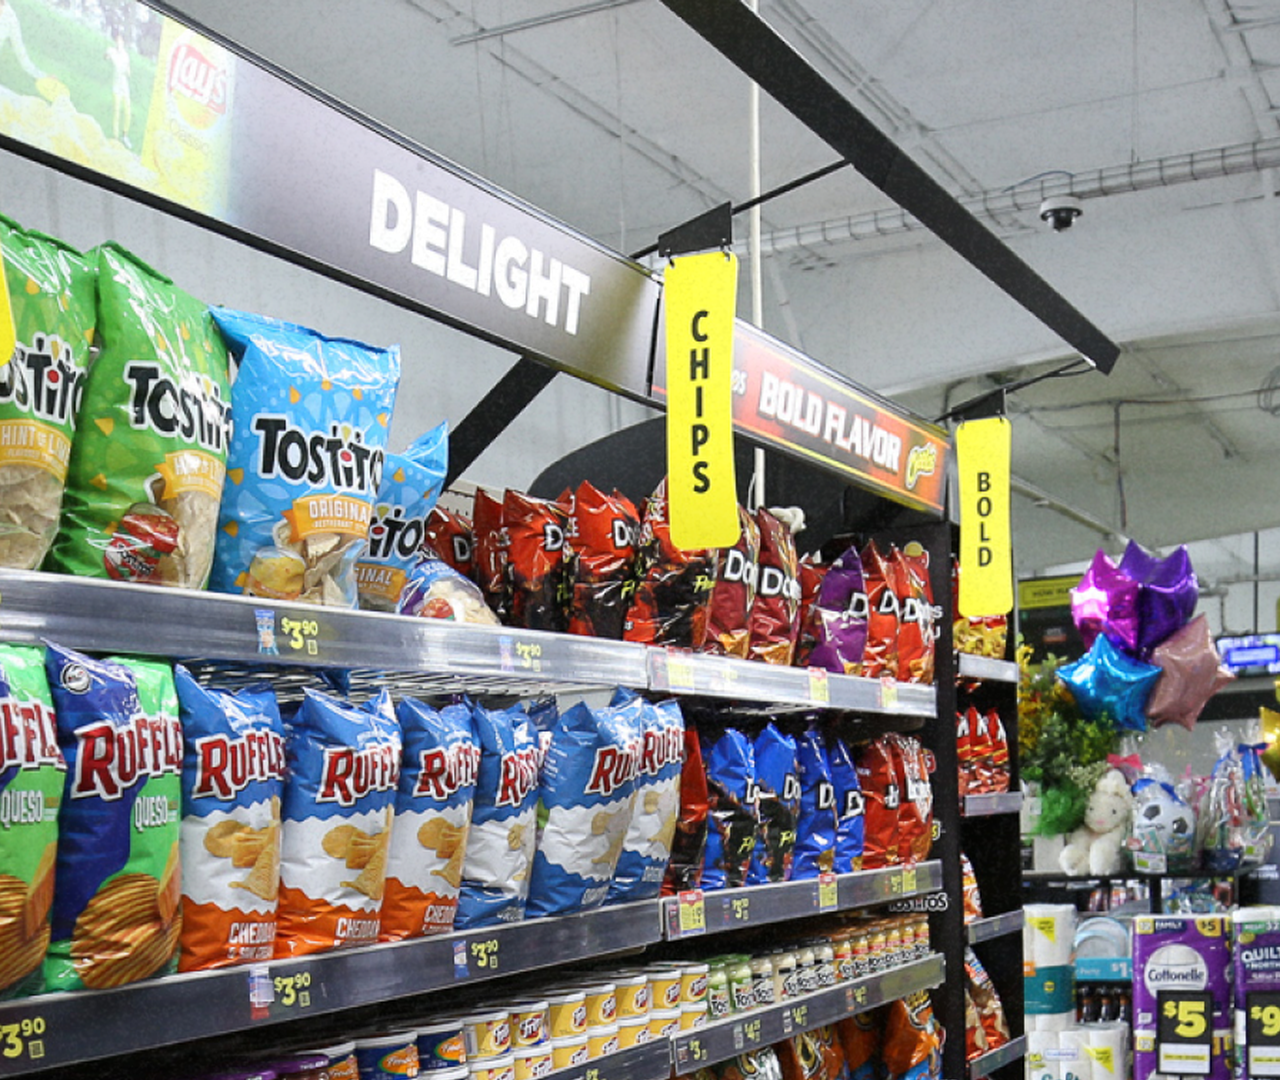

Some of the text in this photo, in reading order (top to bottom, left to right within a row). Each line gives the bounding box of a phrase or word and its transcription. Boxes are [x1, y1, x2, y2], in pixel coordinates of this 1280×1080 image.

[368, 168, 590, 335] DELIGHT
[691, 311, 709, 494] CHIPS
[759, 371, 901, 473] BOLD FLAVOR
[977, 472, 992, 567] BOLD
[0, 790, 44, 831] QUESO
[135, 796, 168, 831] QUESO
[1148, 967, 1204, 983] Cottonelle
[1163, 1001, 1207, 1038] $5
